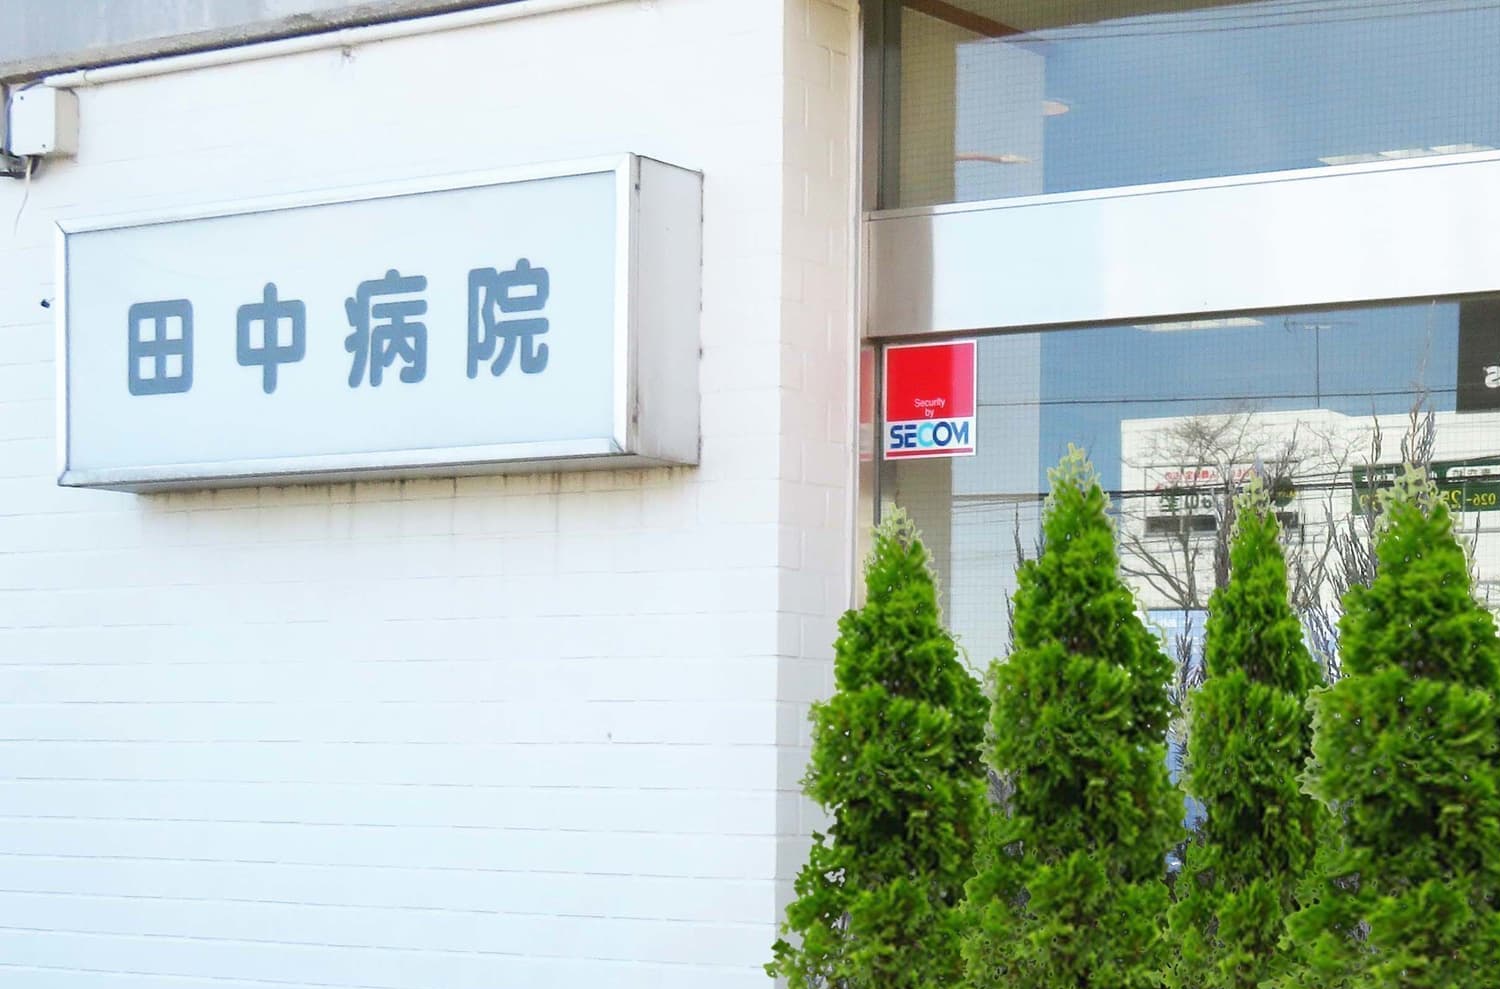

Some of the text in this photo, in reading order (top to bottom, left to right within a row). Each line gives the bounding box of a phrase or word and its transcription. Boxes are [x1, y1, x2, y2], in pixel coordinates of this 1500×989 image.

[128, 258, 549, 396] 田中病院
[914, 398, 945, 408] Security
[925, 408, 934, 418] by
[890, 421, 969, 449] SECOM
